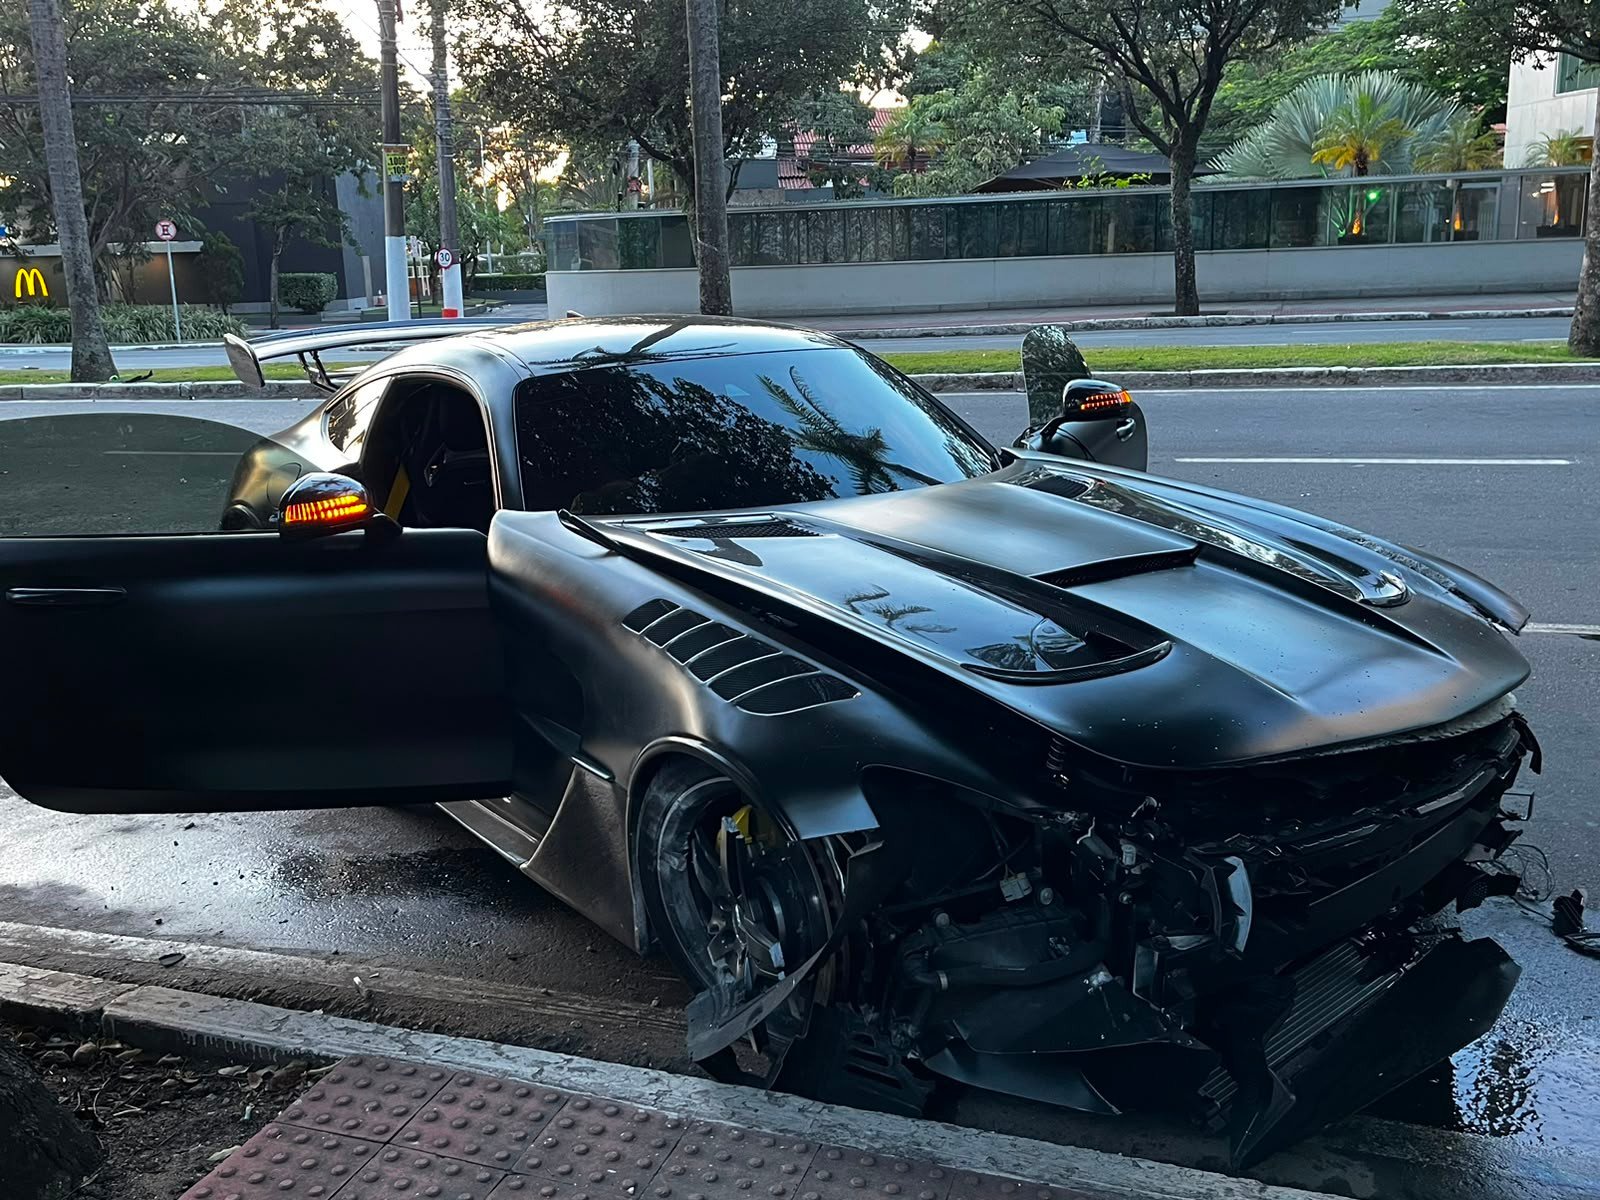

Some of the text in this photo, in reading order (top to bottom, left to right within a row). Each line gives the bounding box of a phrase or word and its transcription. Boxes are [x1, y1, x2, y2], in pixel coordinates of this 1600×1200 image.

[162, 225, 171, 236] E
[439, 252, 451, 262] 30
[15, 268, 49, 298] M
